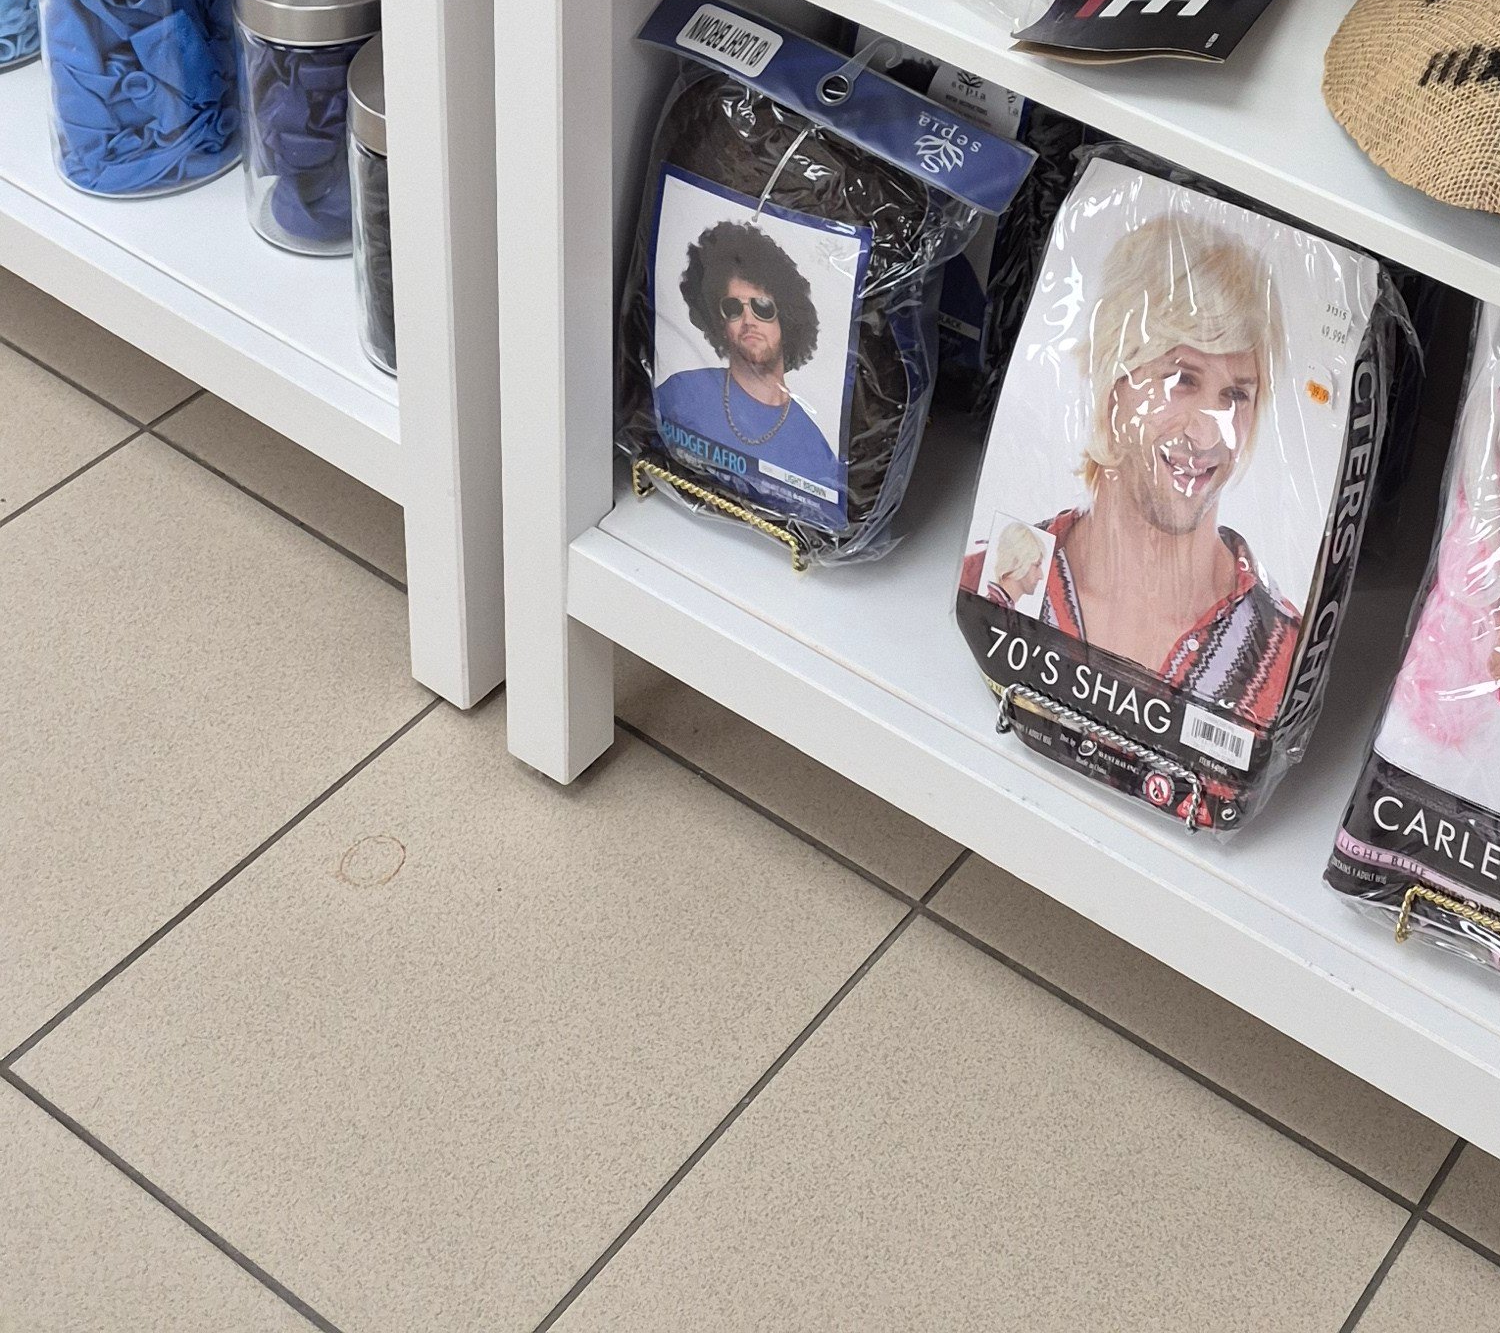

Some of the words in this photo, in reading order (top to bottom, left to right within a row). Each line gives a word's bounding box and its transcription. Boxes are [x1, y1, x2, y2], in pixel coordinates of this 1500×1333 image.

[718, 27, 760, 62] LIGHT
[918, 114, 982, 153] sepia
[662, 421, 710, 459] BUDGET
[712, 445, 747, 475] AFRO
[986, 626, 1061, 685] 70'S
[1072, 665, 1172, 734] SHAG
[1340, 836, 1382, 862] LIGHT
[1391, 856, 1426, 876] BLUE
